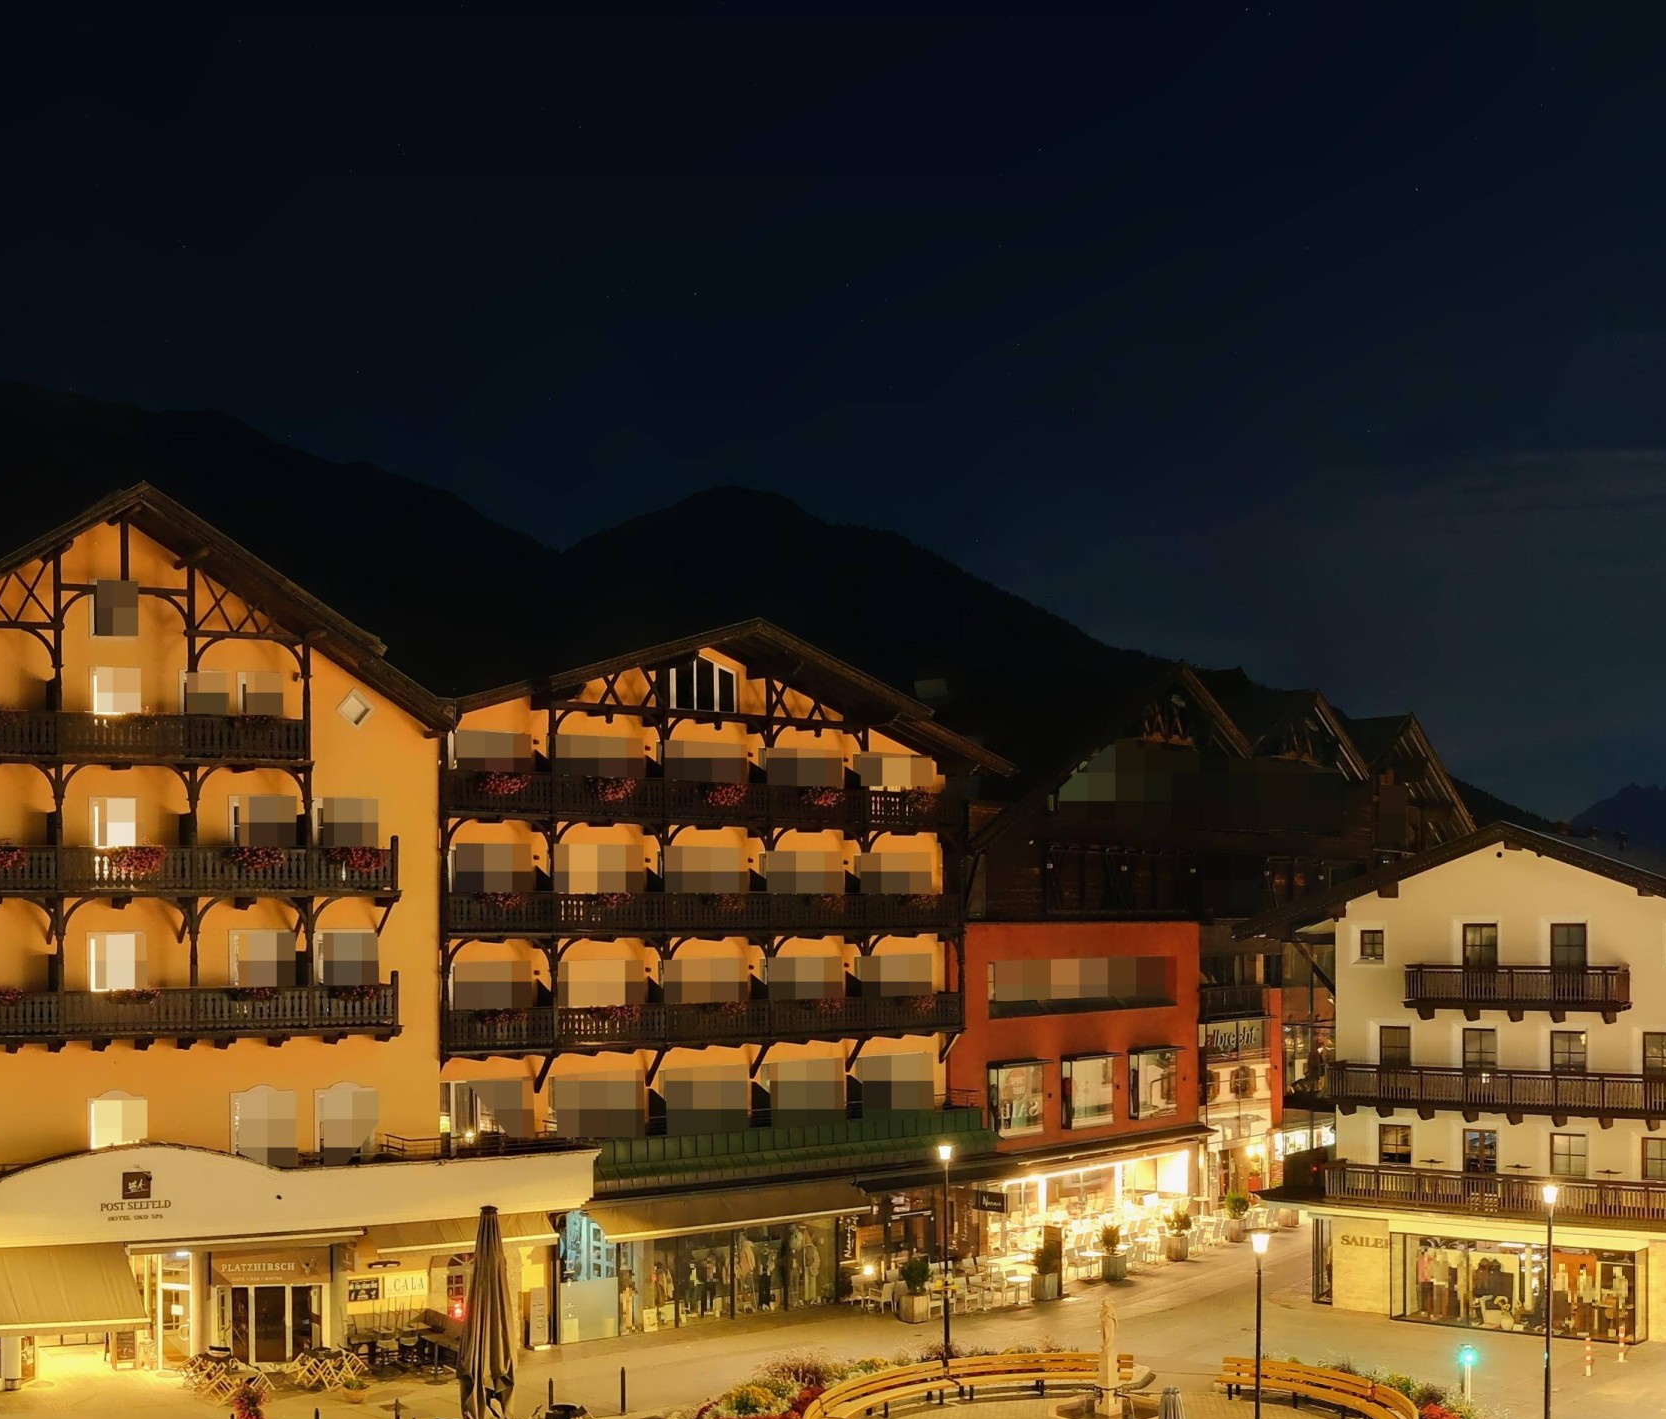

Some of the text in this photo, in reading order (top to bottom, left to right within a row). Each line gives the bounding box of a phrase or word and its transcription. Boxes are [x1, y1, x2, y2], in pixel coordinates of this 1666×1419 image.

[100, 1199, 172, 1212] POST SEEFELD
[221, 1262, 295, 1272] PLATZHIRSCH
[393, 1275, 425, 1293] CALA
